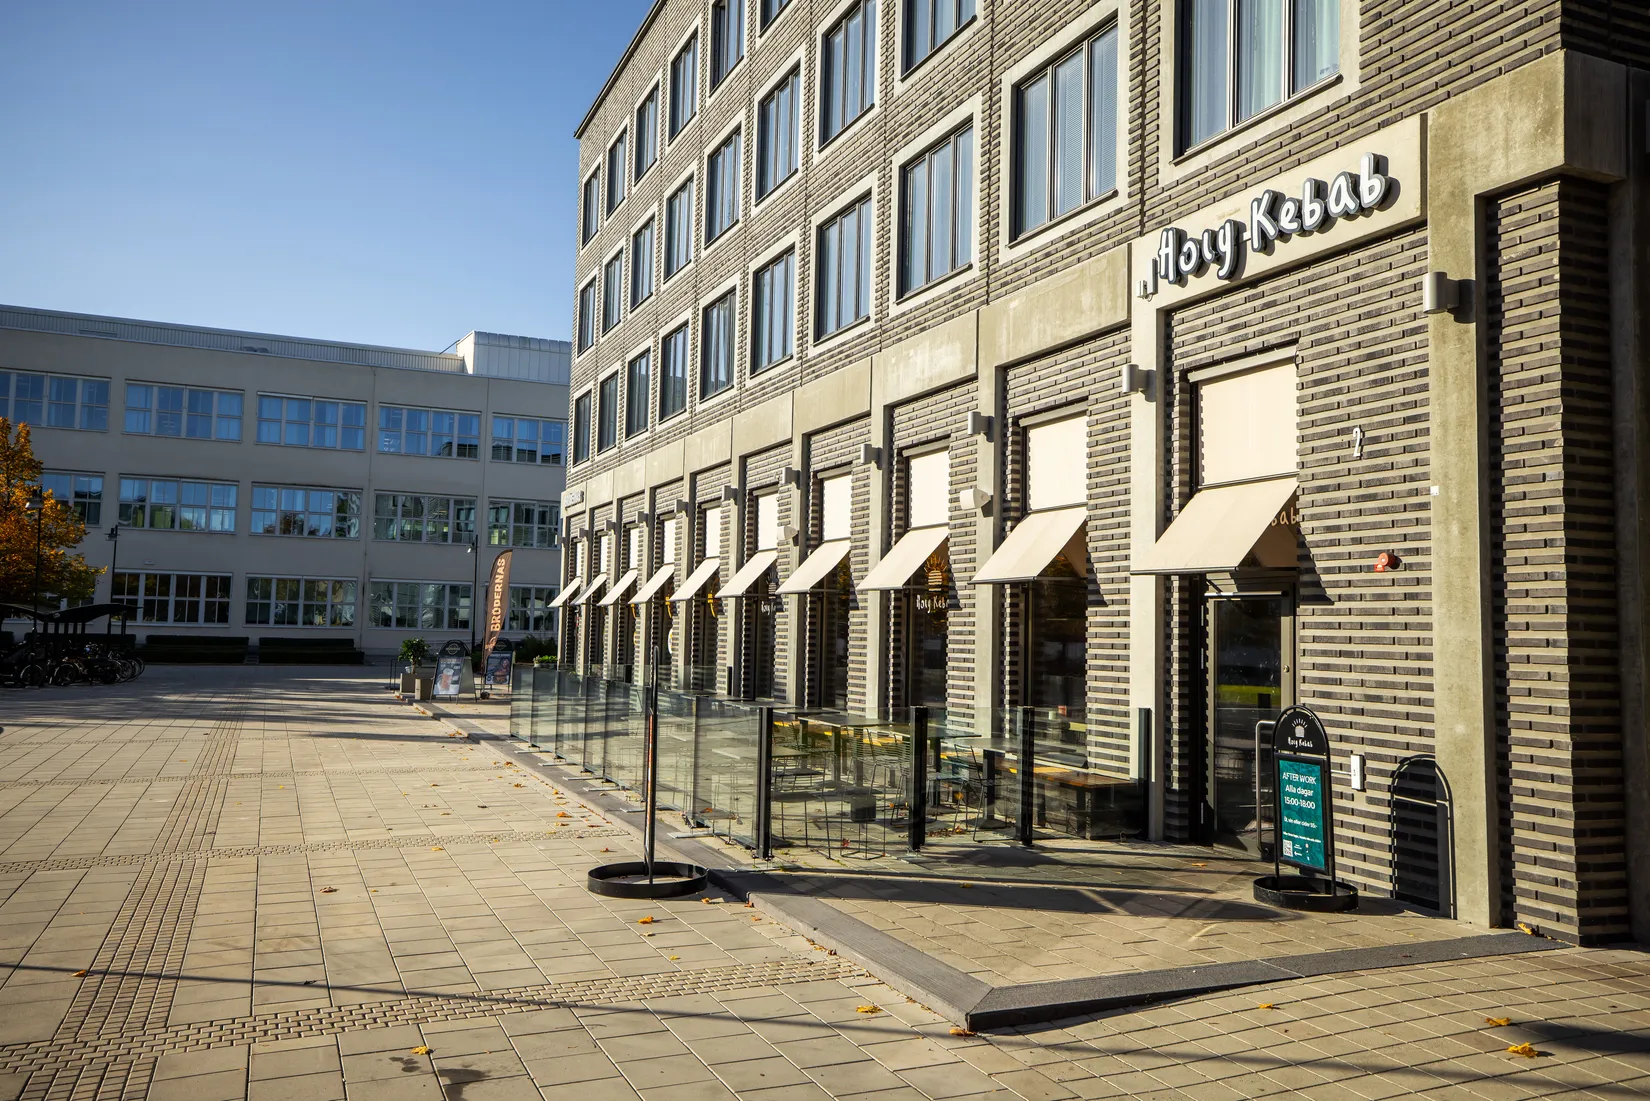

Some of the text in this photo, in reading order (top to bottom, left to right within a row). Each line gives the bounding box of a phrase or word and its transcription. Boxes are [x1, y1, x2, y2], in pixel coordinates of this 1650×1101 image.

[1251, 152, 1386, 253] Kebab
[1352, 427, 1362, 457] 2
[490, 558, 506, 632] BRÖDERNAS
[1282, 772, 1317, 785] AFTER WORK
[1285, 784, 1314, 798] Alla dagar
